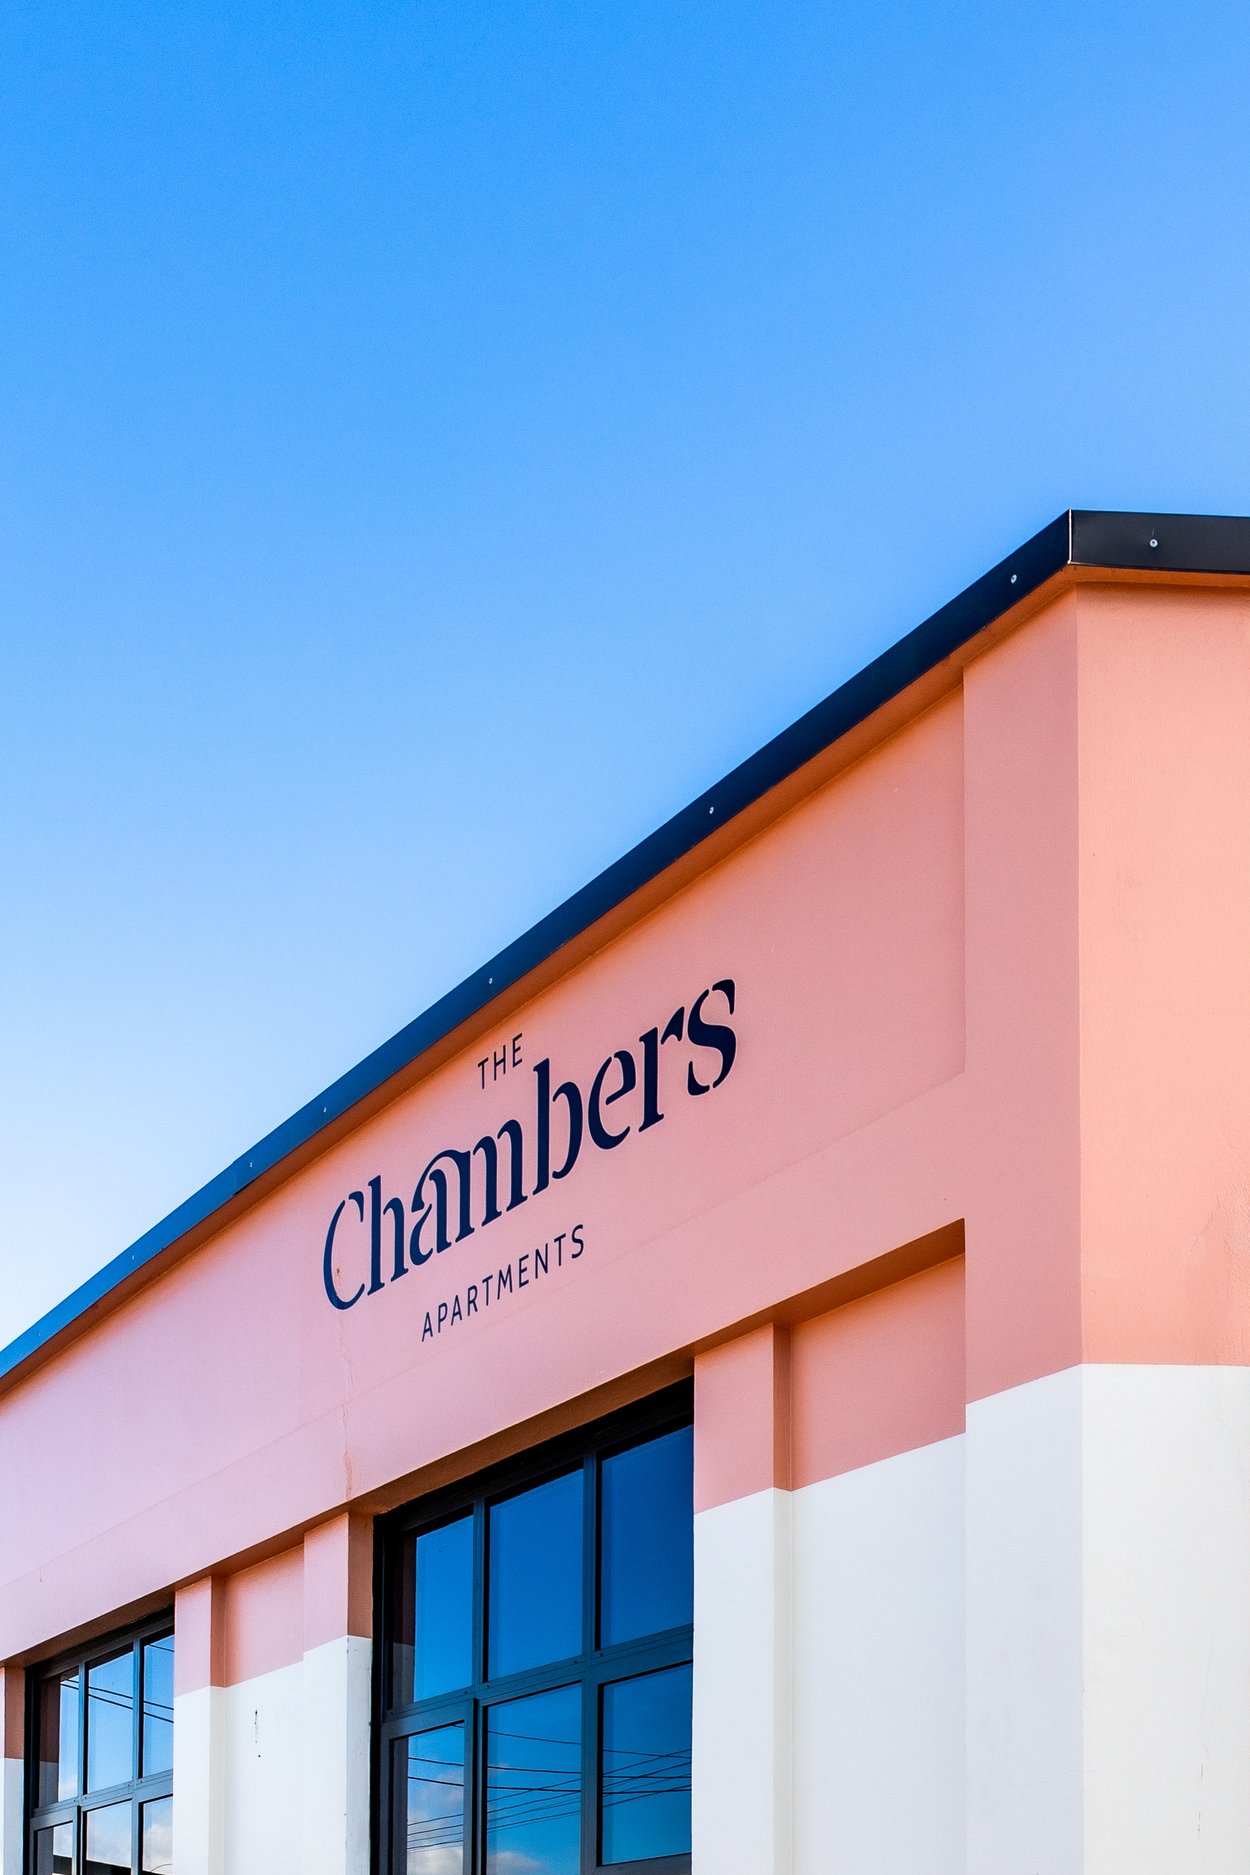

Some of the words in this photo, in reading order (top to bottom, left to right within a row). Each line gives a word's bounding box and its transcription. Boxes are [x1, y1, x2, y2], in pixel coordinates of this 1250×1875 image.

[477, 1033, 523, 1090] THE
[322, 978, 738, 1311] Chambers
[421, 1224, 585, 1343] APARTMENTS
